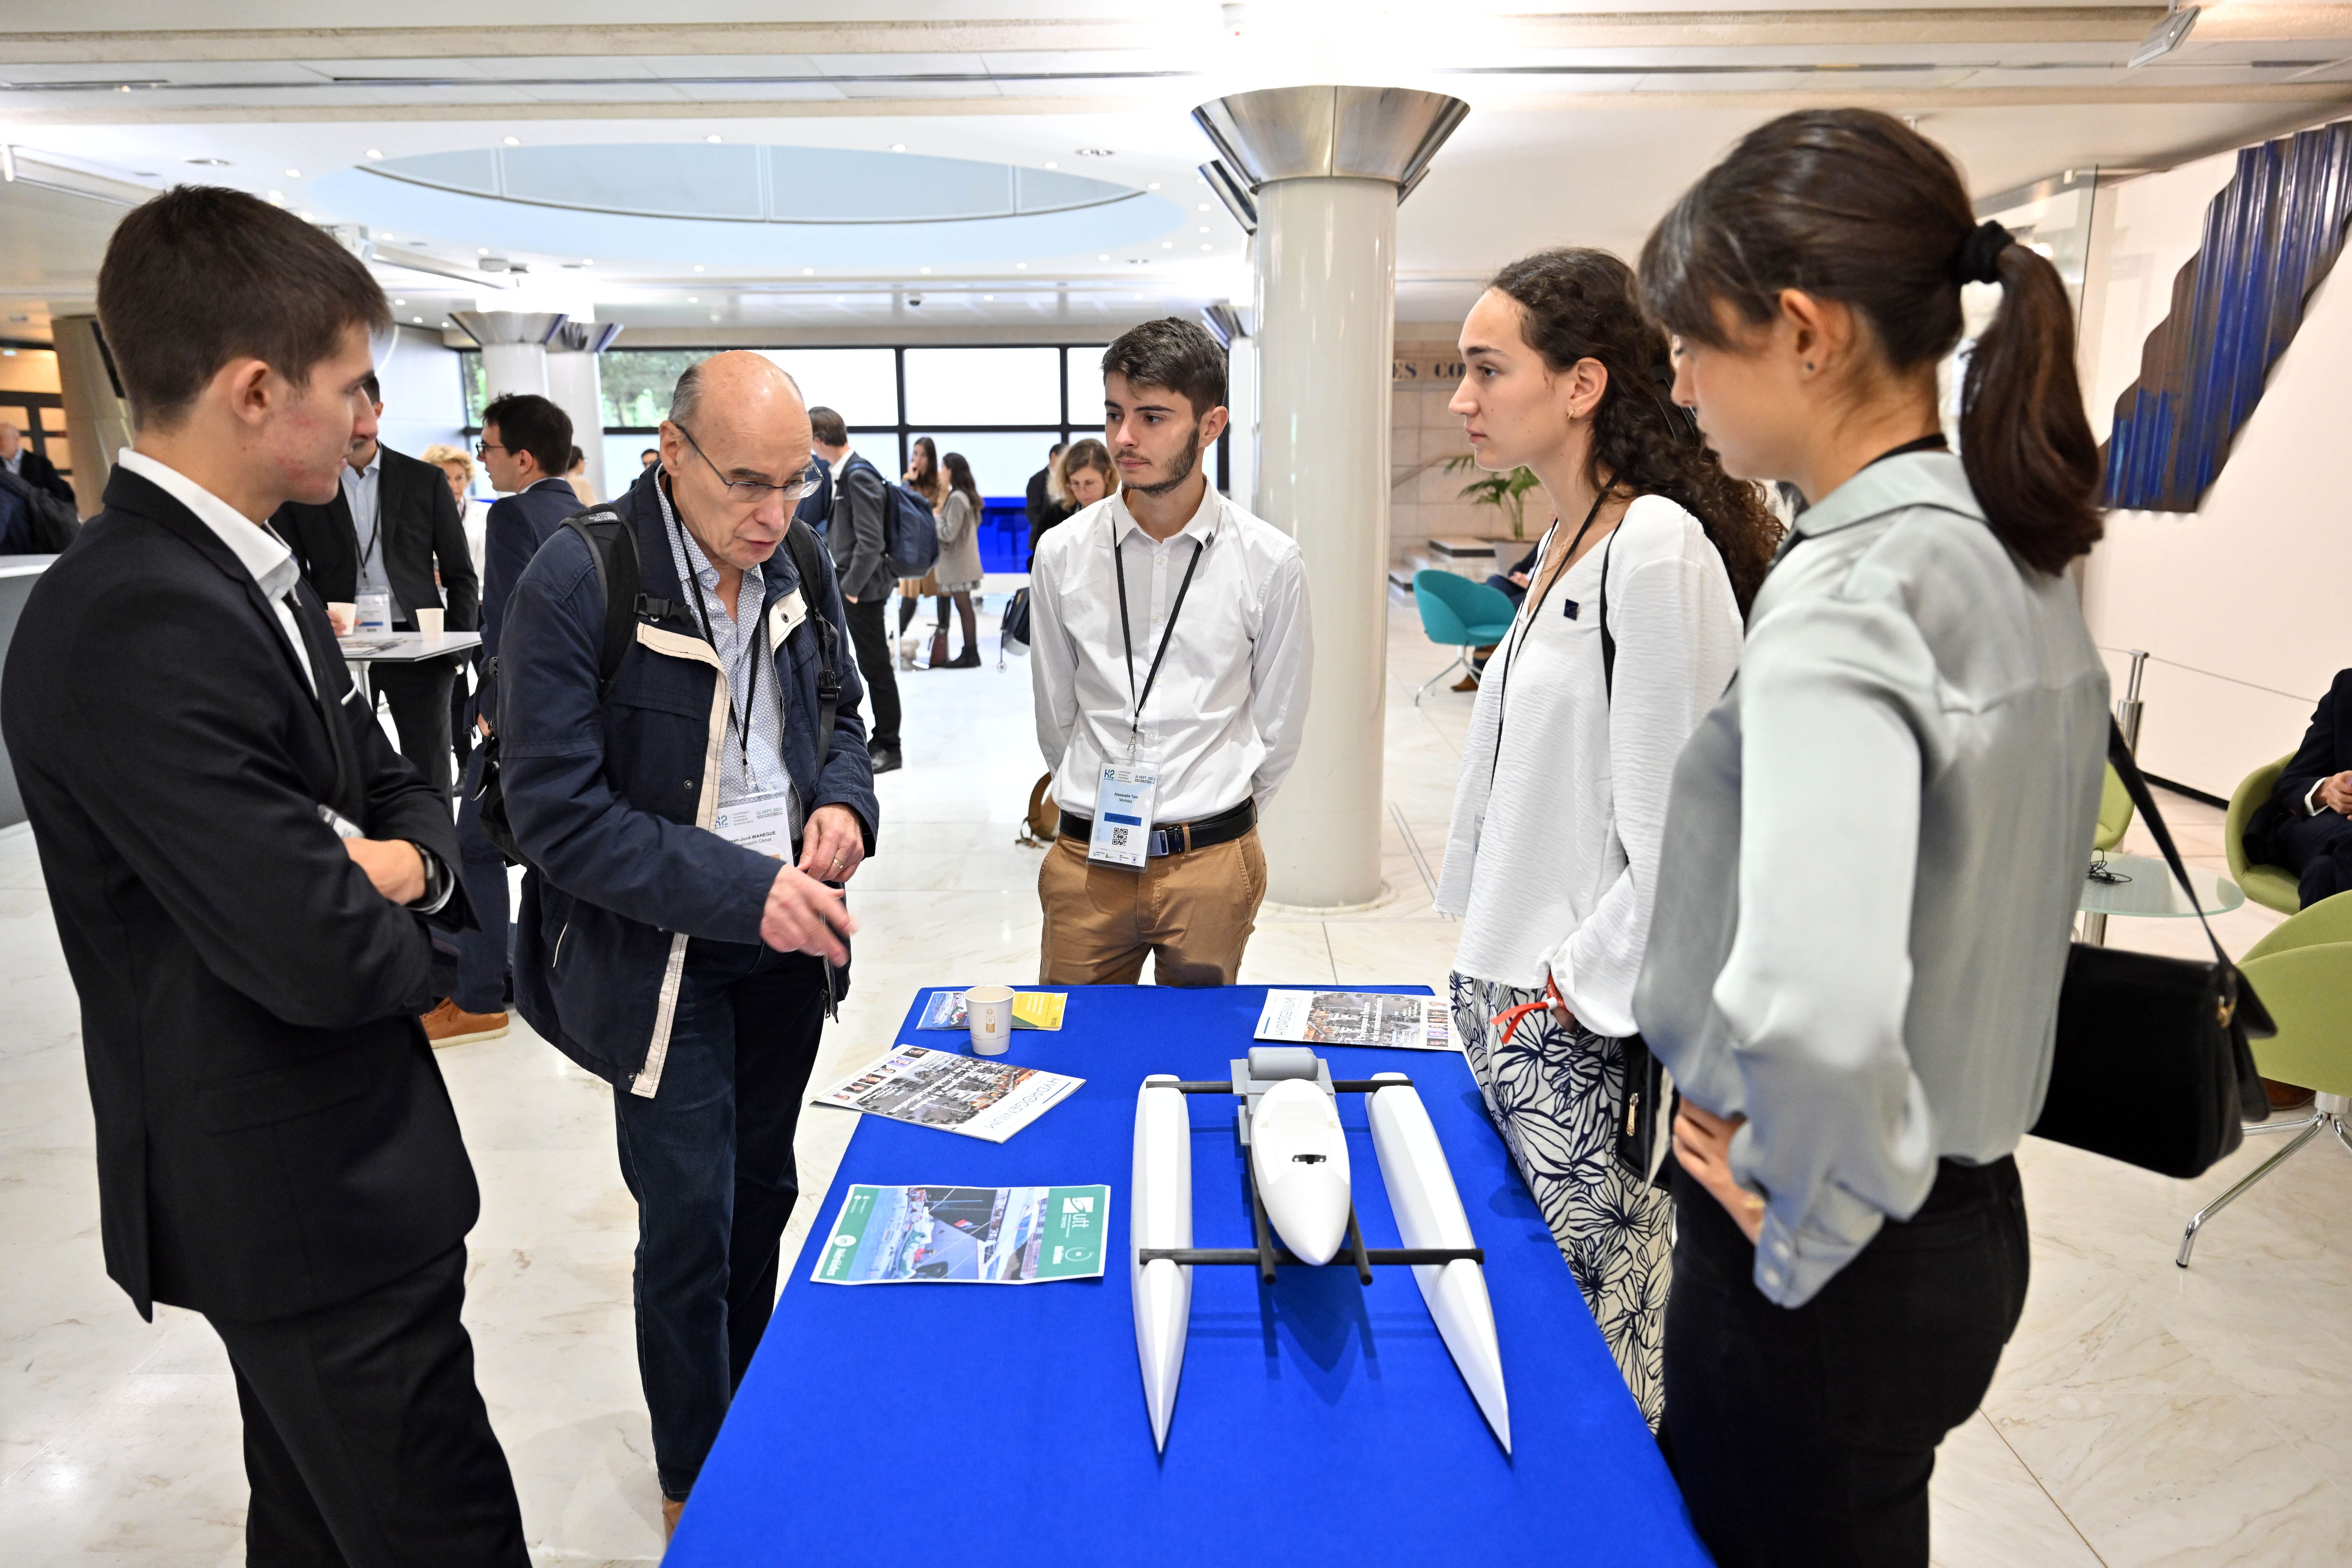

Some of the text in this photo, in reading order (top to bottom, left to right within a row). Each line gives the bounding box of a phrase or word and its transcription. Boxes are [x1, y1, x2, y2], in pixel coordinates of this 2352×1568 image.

[1434, 362, 1466, 378] CO
[1104, 768, 1115, 779] H2
[1274, 997, 1296, 1035] HYDROGENIUM
[941, 1062, 990, 1092] L'hydrogène
[888, 1072, 956, 1113] réindustrialisation
[908, 1095, 940, 1111] l'heure
[983, 1077, 1062, 1129] HYDROGENIUM
[1071, 1213, 1090, 1228] utt
